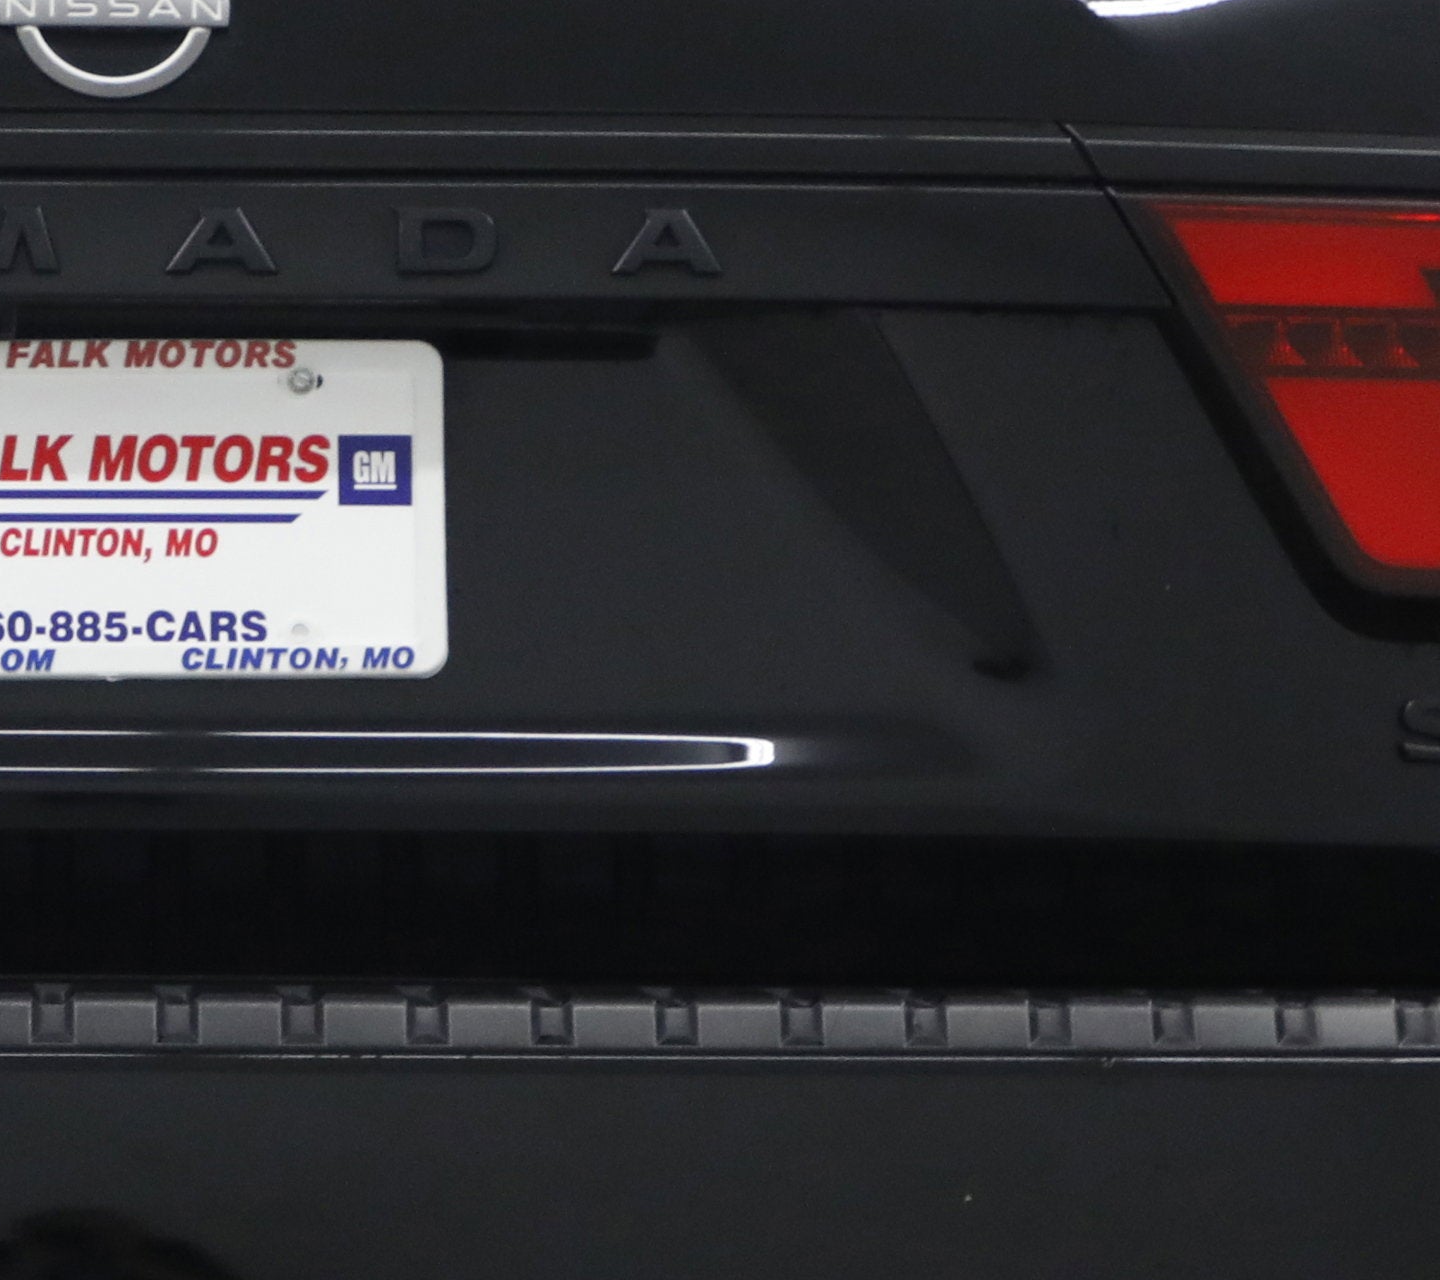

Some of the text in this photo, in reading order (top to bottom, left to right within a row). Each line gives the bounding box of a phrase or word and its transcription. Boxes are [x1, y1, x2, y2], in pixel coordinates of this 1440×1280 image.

[6, 341, 111, 368] FALK
[124, 340, 297, 368] MOTORS
[89, 435, 331, 483] MOTORS
[353, 451, 397, 484] GM
[0, 529, 219, 563] CLINTON, MO
[181, 646, 415, 671] CLINTON, MO
